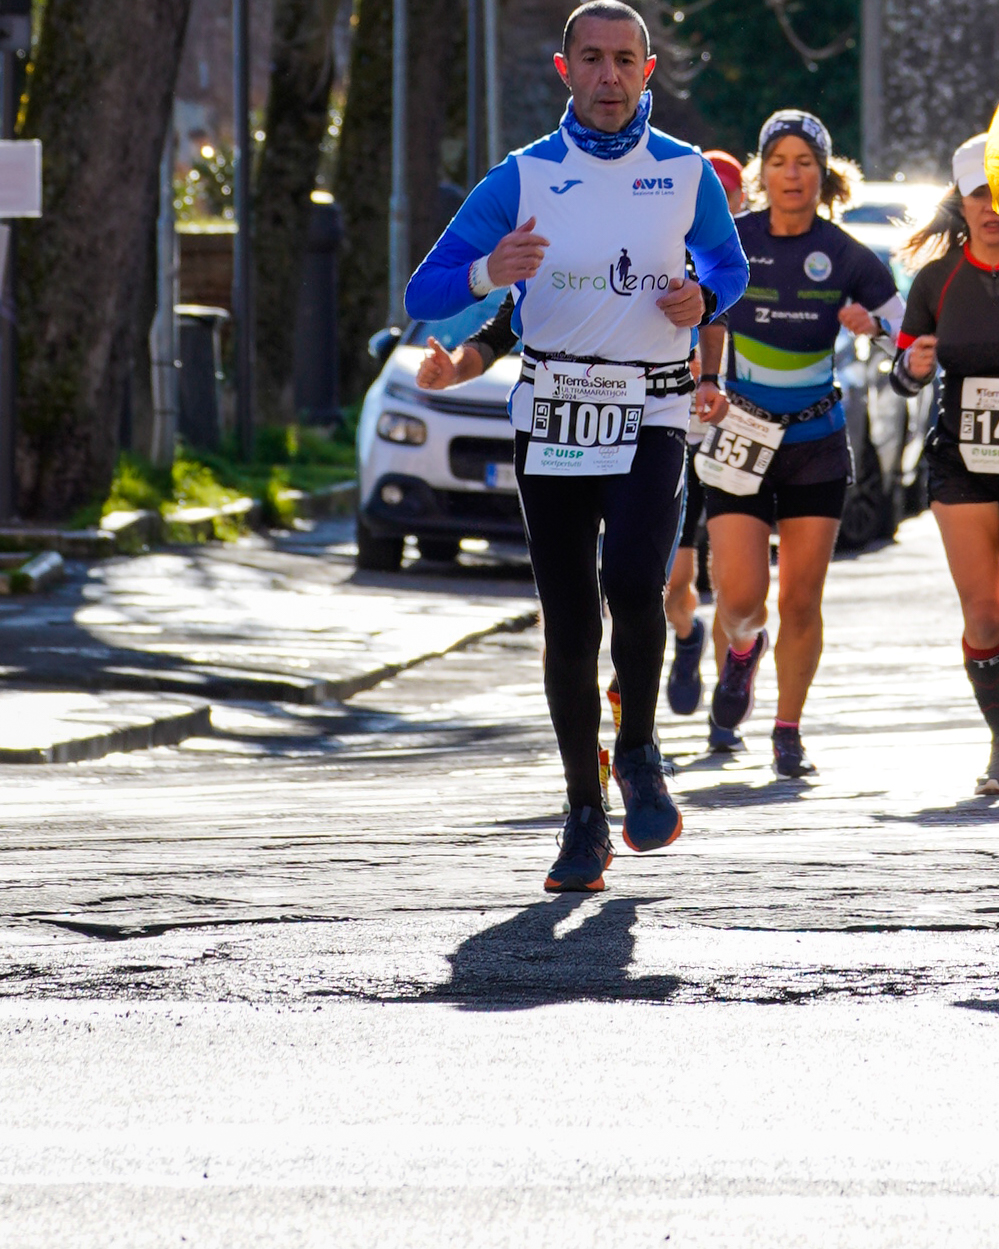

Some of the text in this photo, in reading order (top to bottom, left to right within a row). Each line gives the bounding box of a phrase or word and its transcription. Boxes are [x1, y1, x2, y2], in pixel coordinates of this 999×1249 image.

[632, 177, 674, 190] AVIS
[560, 374, 588, 388] Terre
[593, 376, 627, 389] Siena
[561, 386, 627, 397] ULTRAMARATHON
[555, 402, 622, 447] 100
[555, 448, 584, 459] UISP
[715, 430, 752, 468] 55
